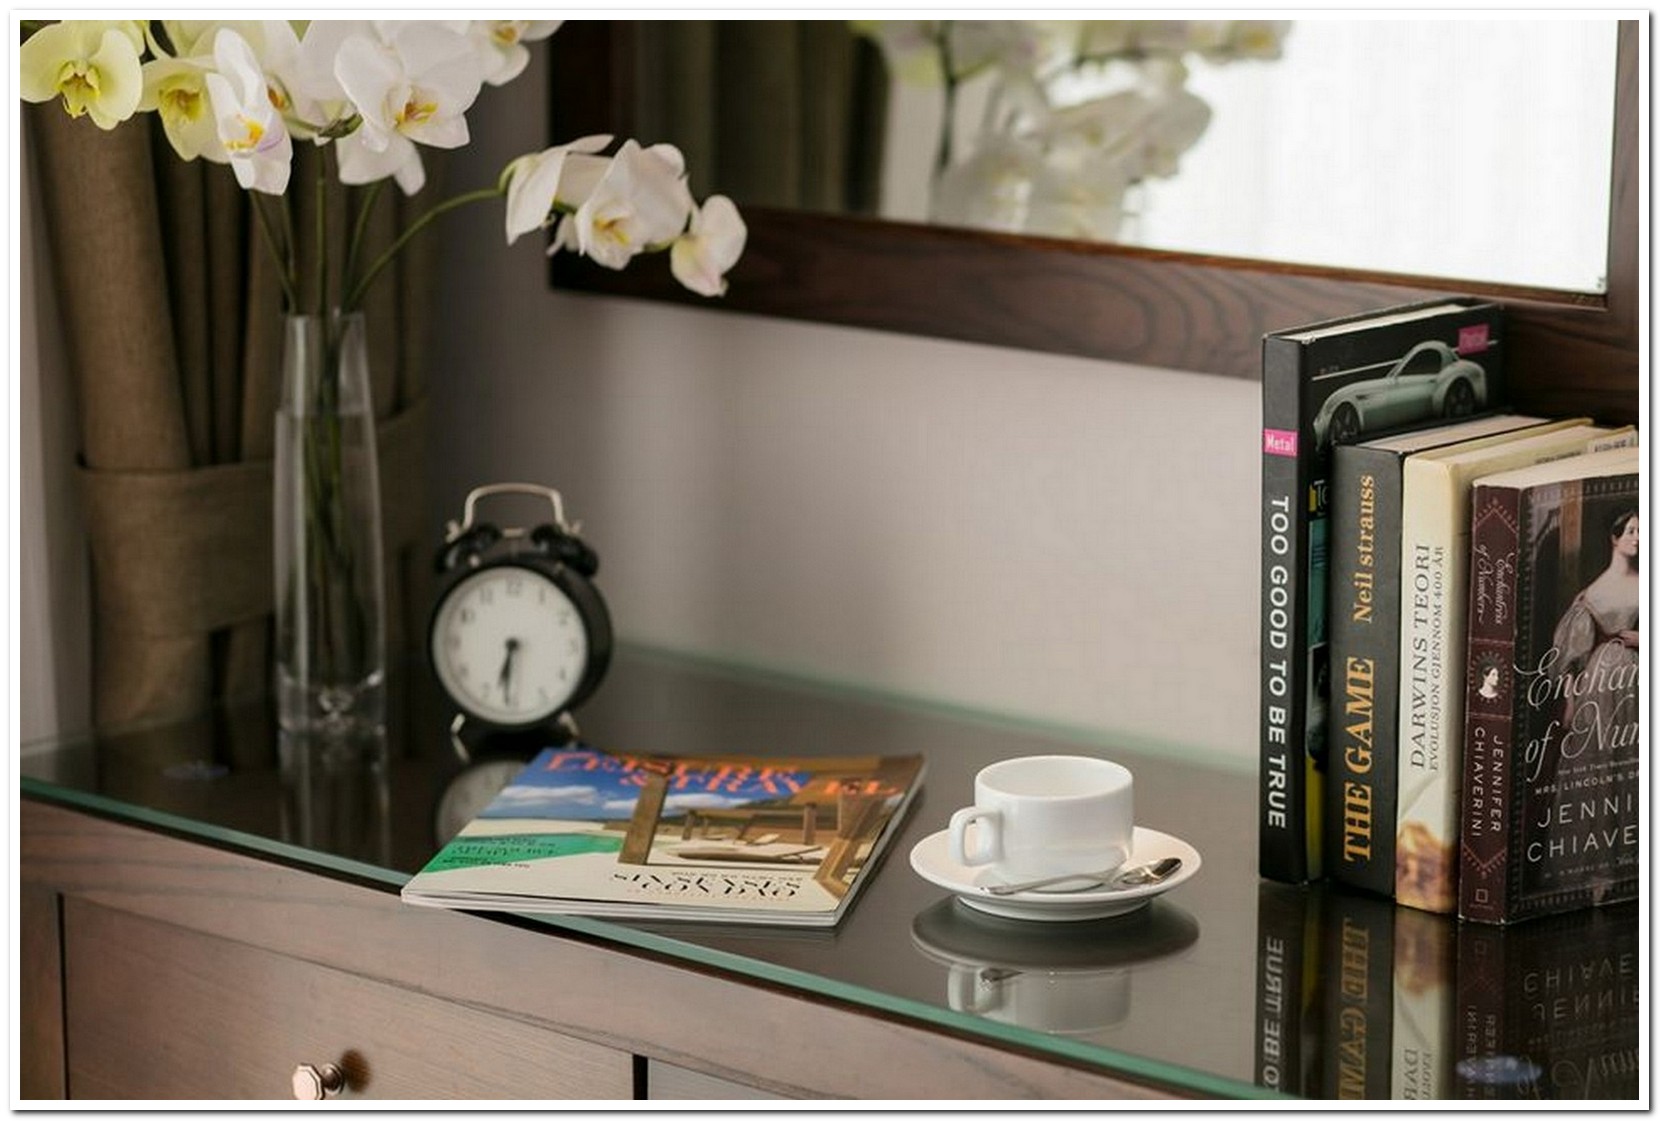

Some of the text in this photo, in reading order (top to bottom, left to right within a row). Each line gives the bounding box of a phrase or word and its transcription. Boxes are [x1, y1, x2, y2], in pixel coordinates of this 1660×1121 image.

[1265, 434, 1296, 454] Metal
[1353, 475, 1375, 624] Neil strauss
[1267, 496, 1290, 829] TOO GOOD TO BE TRUE
[1410, 544, 1431, 769] DARWINS TEORI
[1430, 603, 1443, 680] GJENNOM
[1343, 657, 1375, 862] THE GAME
[1429, 683, 1442, 772] EVOLUSJON
[1524, 720, 1560, 783] of
[1471, 726, 1487, 837] CHIAVERINI
[1489, 735, 1504, 832] JENNIFER
[1526, 823, 1638, 864] CHIAVE
